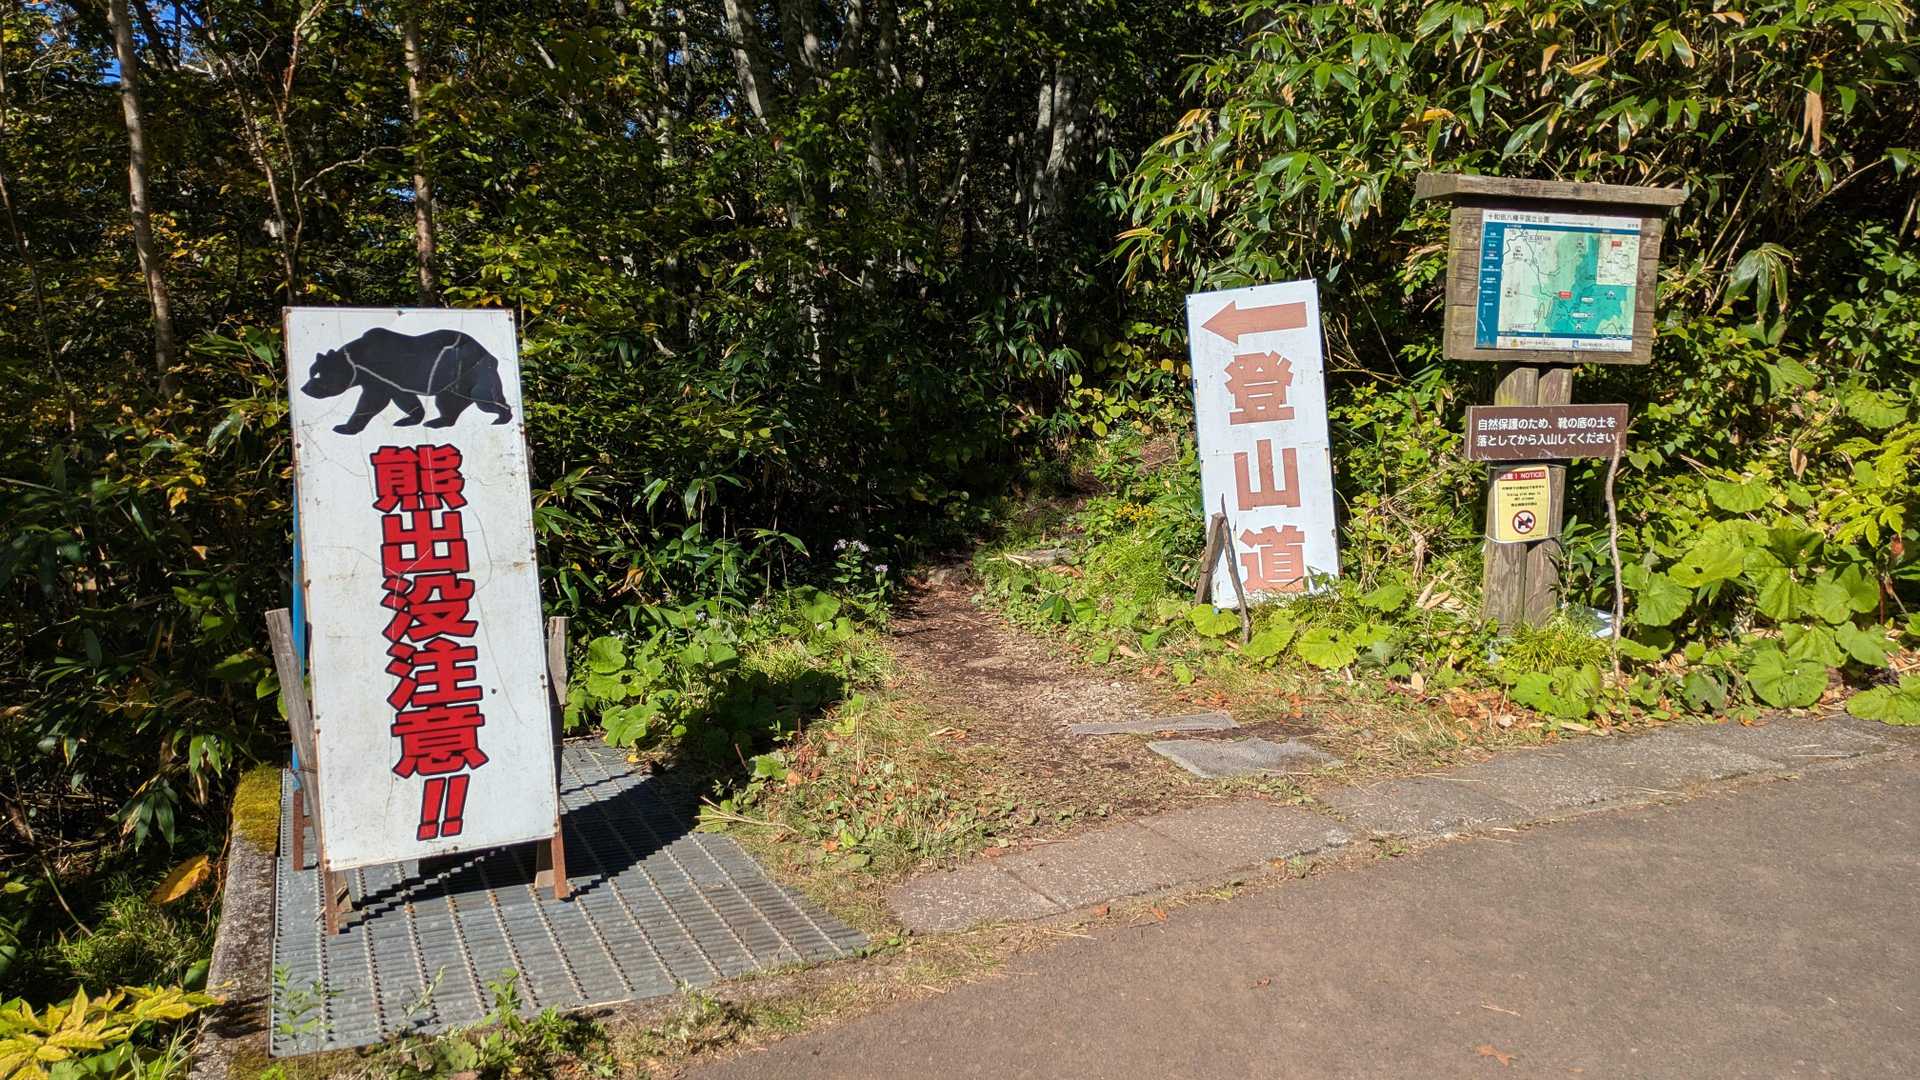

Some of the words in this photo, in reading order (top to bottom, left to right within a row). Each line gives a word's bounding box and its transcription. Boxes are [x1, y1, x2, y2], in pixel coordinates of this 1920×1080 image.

[1224, 350, 1306, 594] 登山道
[1476, 432, 1616, 447] 落としてから入山してください
[370, 444, 489, 841] 熊出没注意!!
